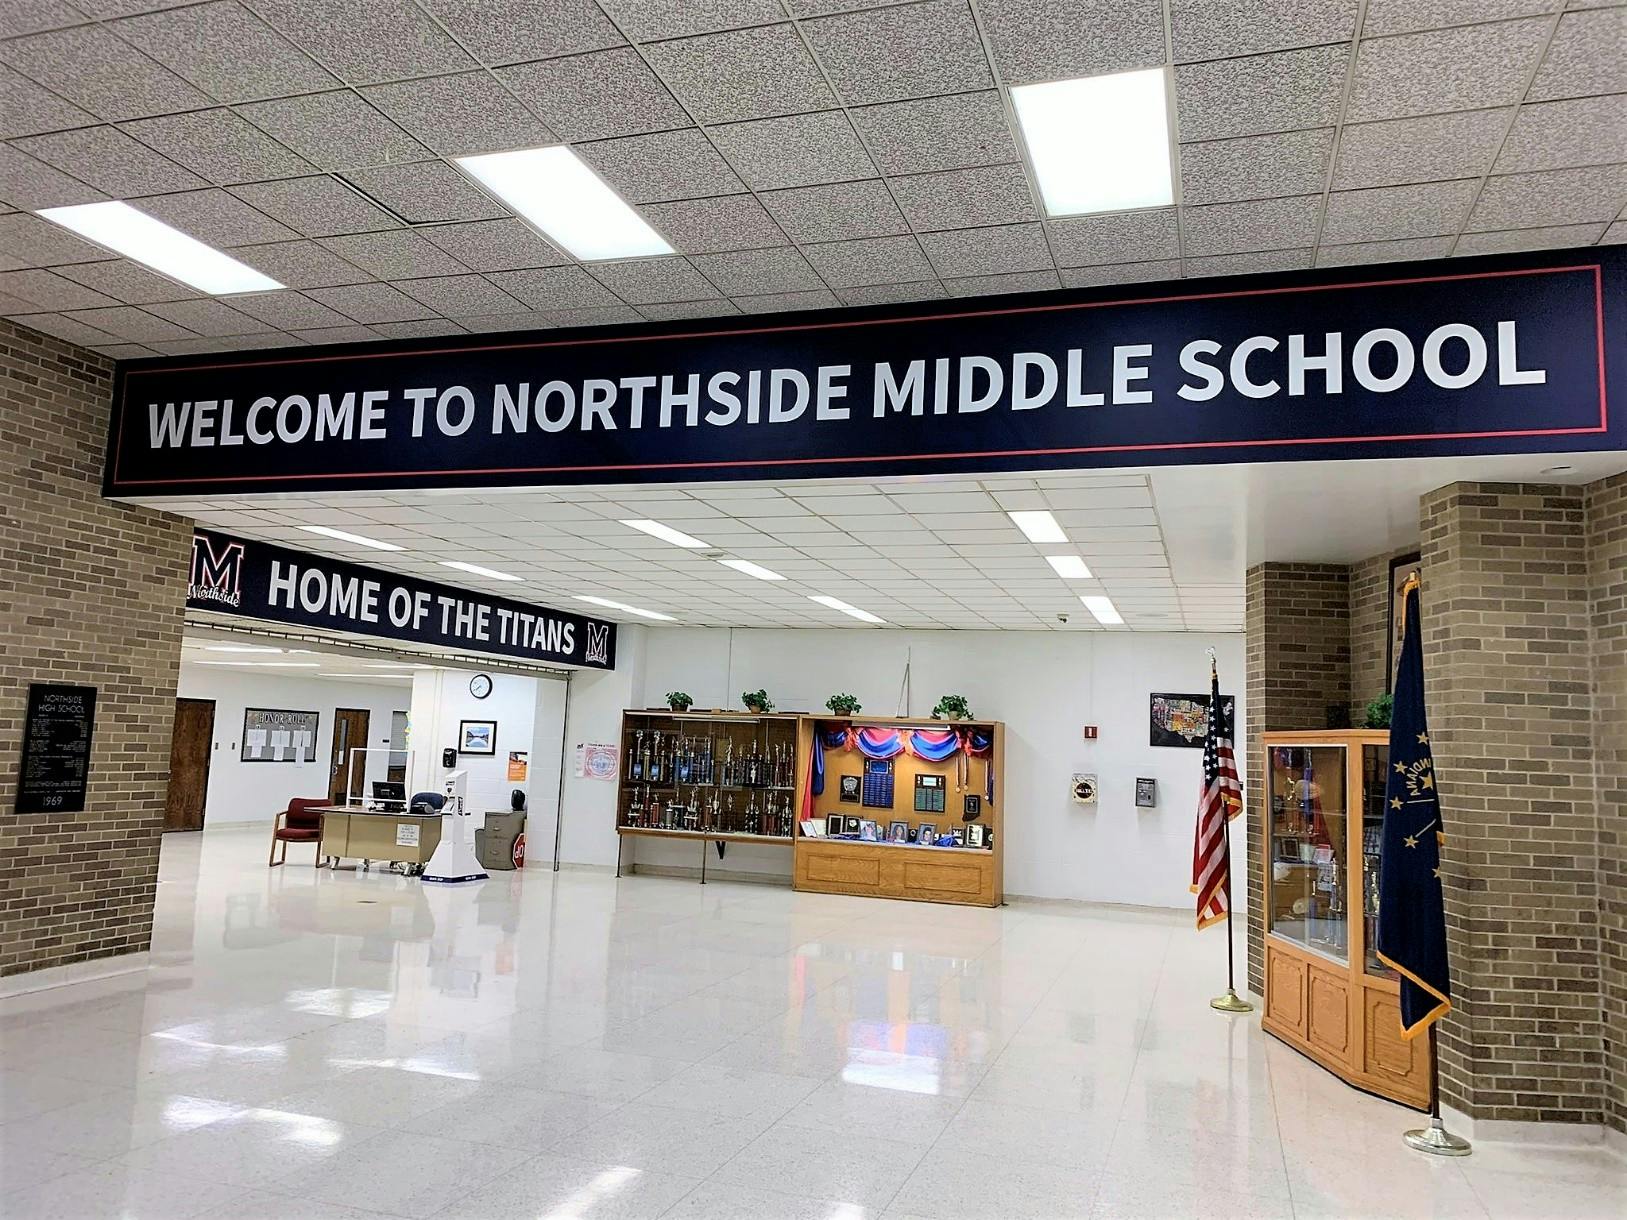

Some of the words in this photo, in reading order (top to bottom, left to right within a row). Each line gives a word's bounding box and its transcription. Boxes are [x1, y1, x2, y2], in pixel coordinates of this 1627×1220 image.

[148, 389, 388, 450] WELCOME
[404, 385, 475, 438] TO
[491, 364, 851, 435] NORTHSIDE
[872, 344, 1153, 418] MIDDLE
[1176, 320, 1546, 402] SCHOOL
[187, 585, 240, 607] Northside
[268, 560, 381, 624] HOME
[388, 586, 432, 631] OF
[437, 597, 491, 641] THE
[497, 609, 576, 655] TITANS
[43, 694, 82, 704] NORTHSIDE
[39, 704, 55, 712] HIGH
[58, 704, 85, 714] SCHOOL
[259, 712, 284, 724] HONOR
[287, 713, 305, 725] ROLL
[43, 796, 63, 806] 1969
